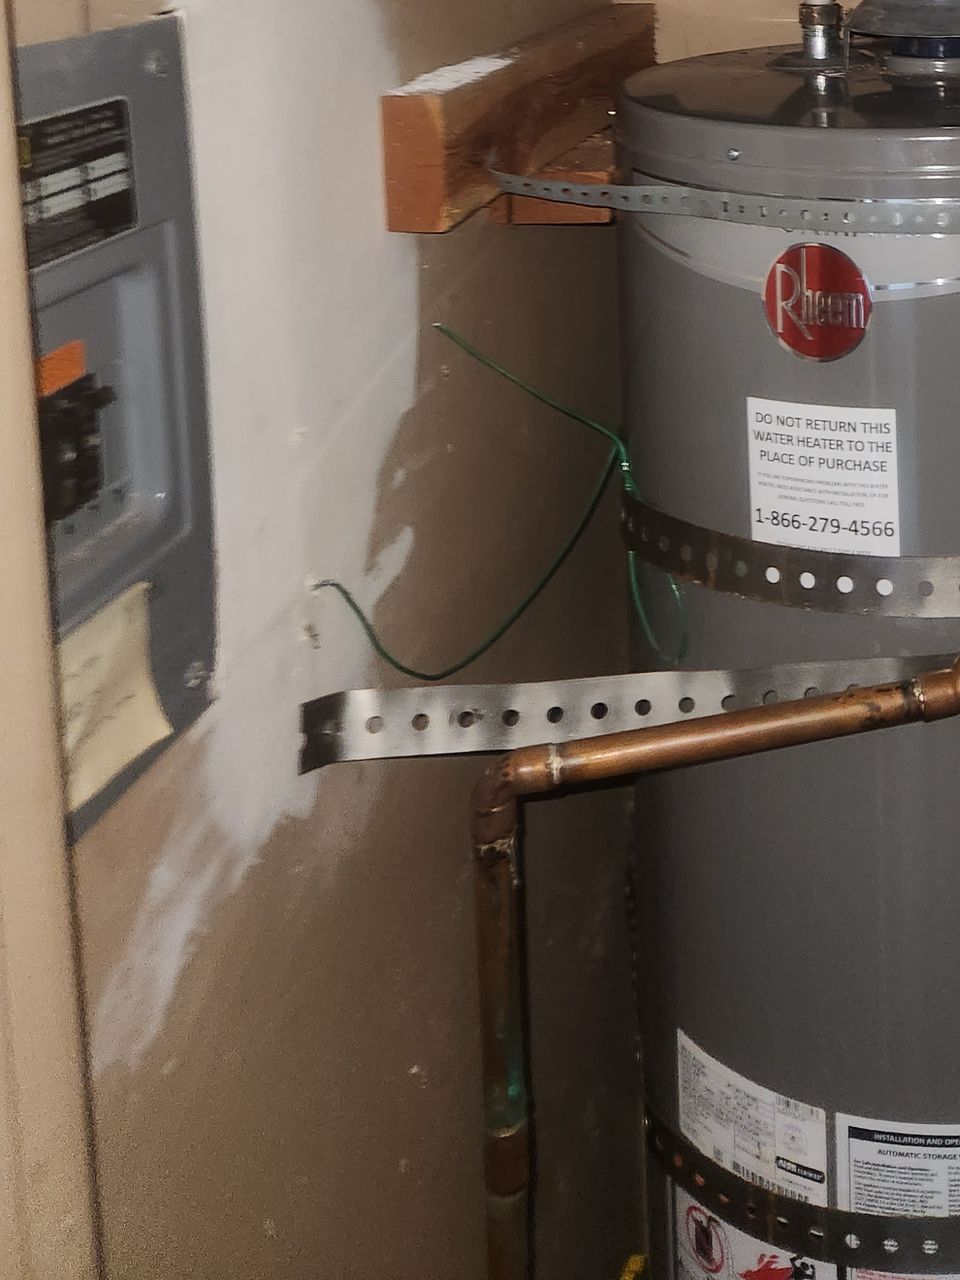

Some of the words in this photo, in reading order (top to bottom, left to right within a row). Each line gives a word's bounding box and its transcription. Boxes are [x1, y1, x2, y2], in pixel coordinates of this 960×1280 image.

[776, 248, 865, 340] Rheem
[755, 411, 772, 424] DO
[776, 415, 802, 429] NOT
[806, 418, 857, 433] RETURN
[861, 422, 891, 434] THIS
[753, 430, 794, 446] WATER
[797, 436, 844, 451] HEATER
[847, 440, 865, 452] TO
[867, 441, 893, 453] THE
[760, 450, 795, 465] PLACE
[798, 455, 815, 467] OF
[818, 457, 888, 472] PURCHASE
[755, 508, 895, 537] 1-866-279-4566
[874, 1133, 925, 1145] INSTALLATION
[926, 1138, 943, 1146] AND
[877, 1149, 922, 1160] AUTOMATIC
[923, 1152, 958, 1160] STORAGE
